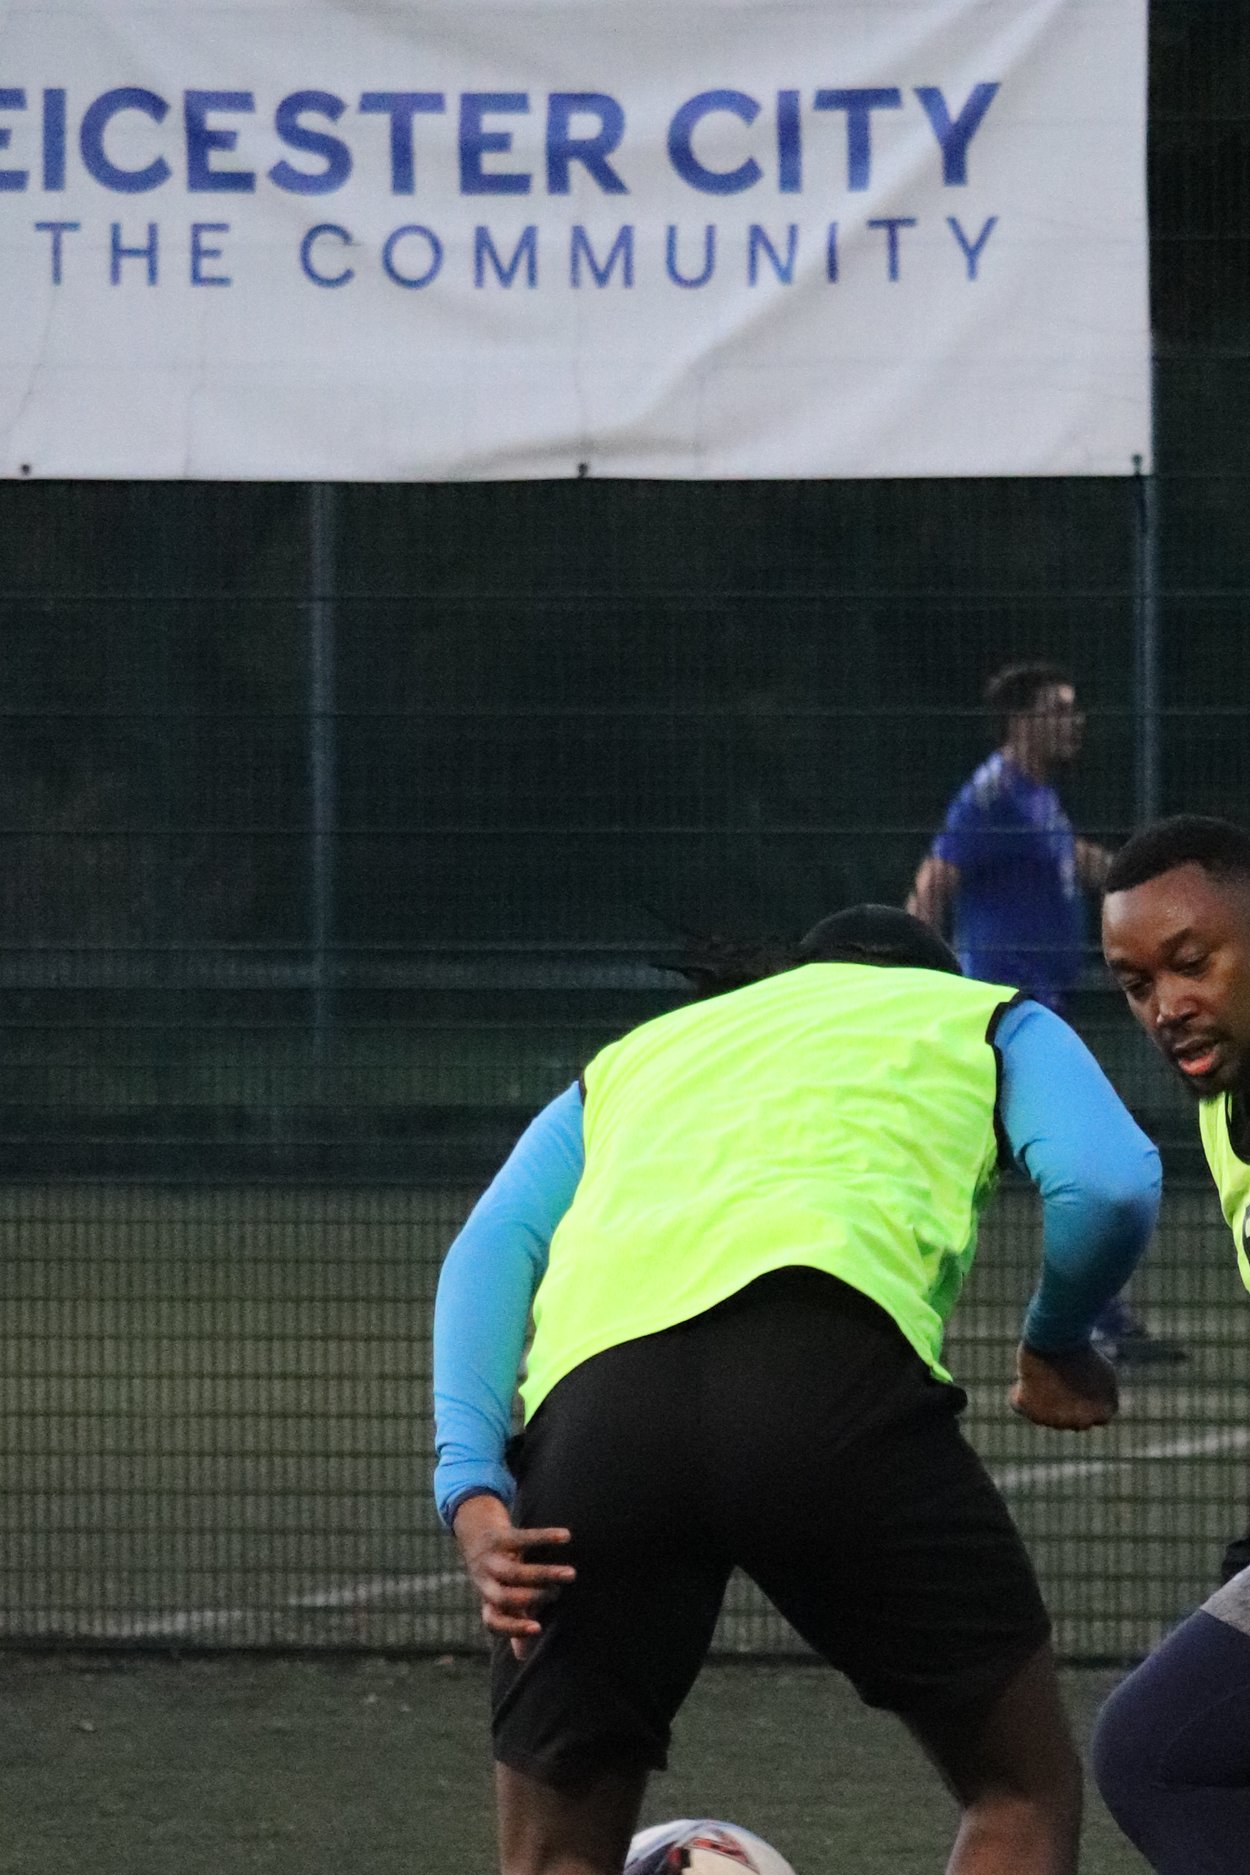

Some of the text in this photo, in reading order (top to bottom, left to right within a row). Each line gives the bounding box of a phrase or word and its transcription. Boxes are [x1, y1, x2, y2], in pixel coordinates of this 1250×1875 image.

[666, 82, 1001, 196] CITY
[34, 216, 998, 290] THE COMMUNITY
